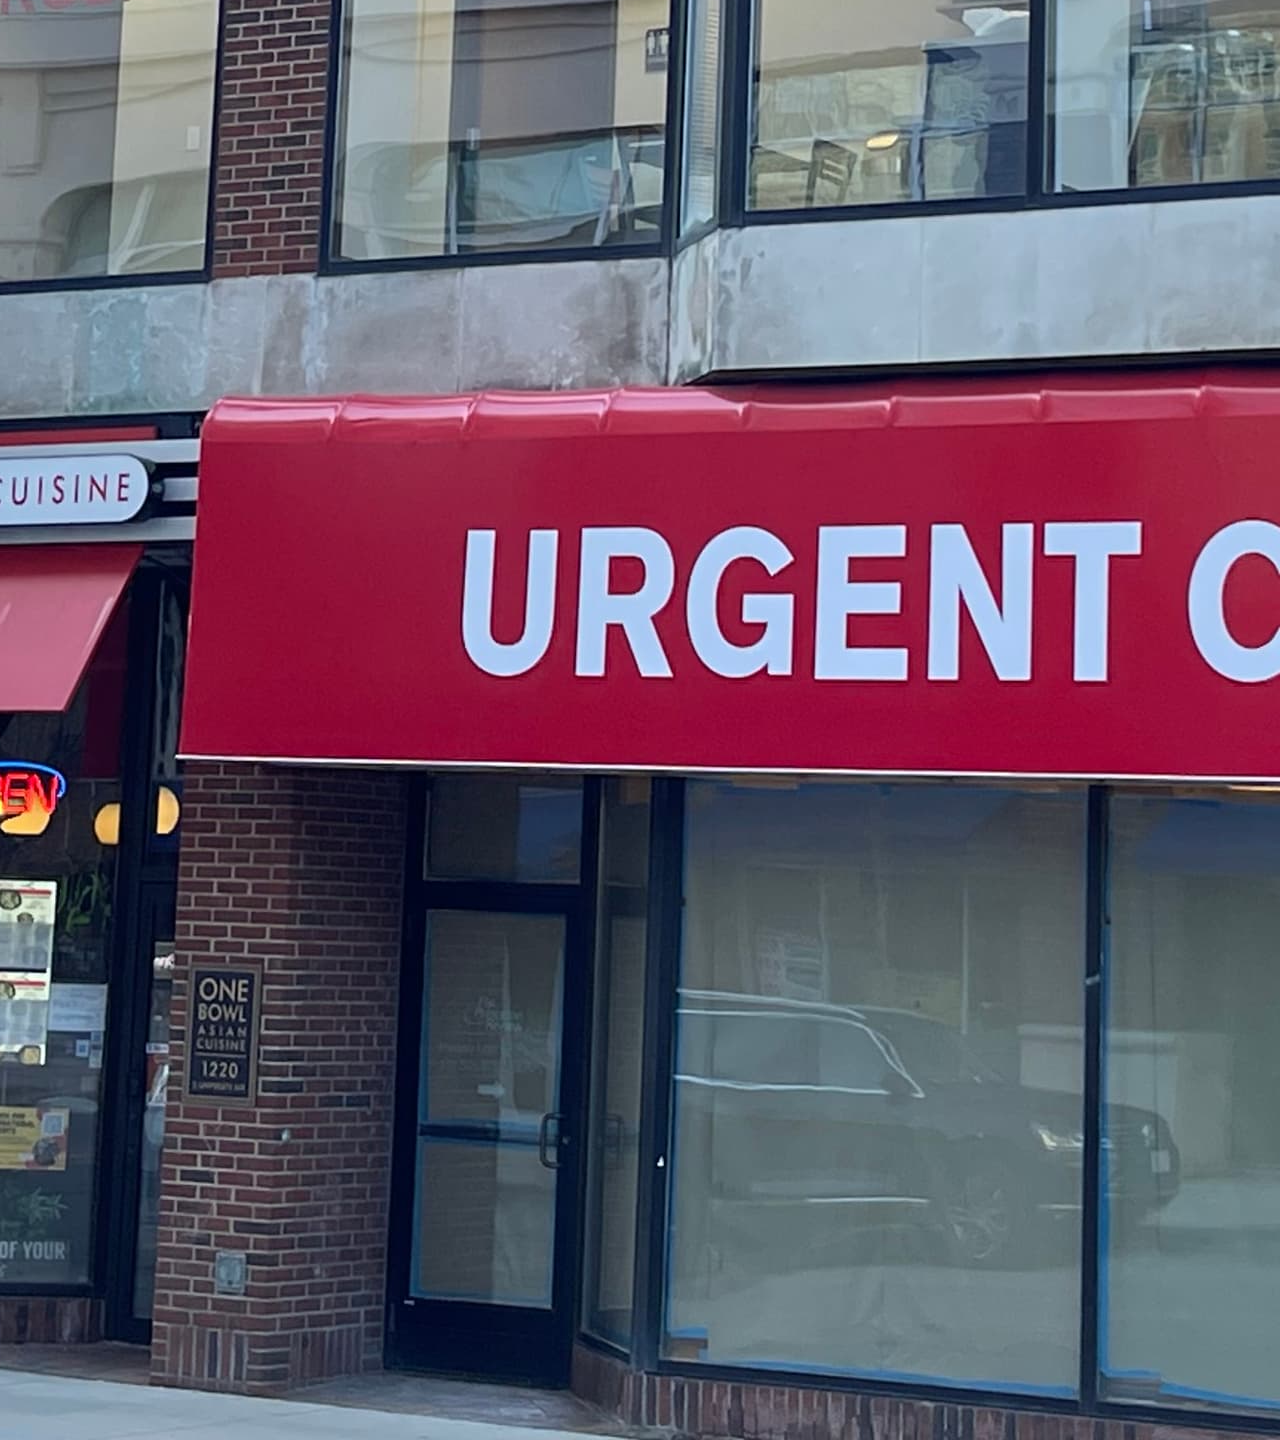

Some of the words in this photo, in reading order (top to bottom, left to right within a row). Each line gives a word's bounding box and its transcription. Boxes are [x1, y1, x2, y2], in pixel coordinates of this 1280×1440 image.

[460, 521, 1142, 682] URGENT
[199, 977, 249, 1002] ONE
[198, 1003, 247, 1022] BOWL
[197, 1024, 247, 1037] ASIAN
[196, 1038, 246, 1052] CUISINE
[201, 1060, 238, 1079] 1220
[22, 1241, 66, 1260] YOUR
